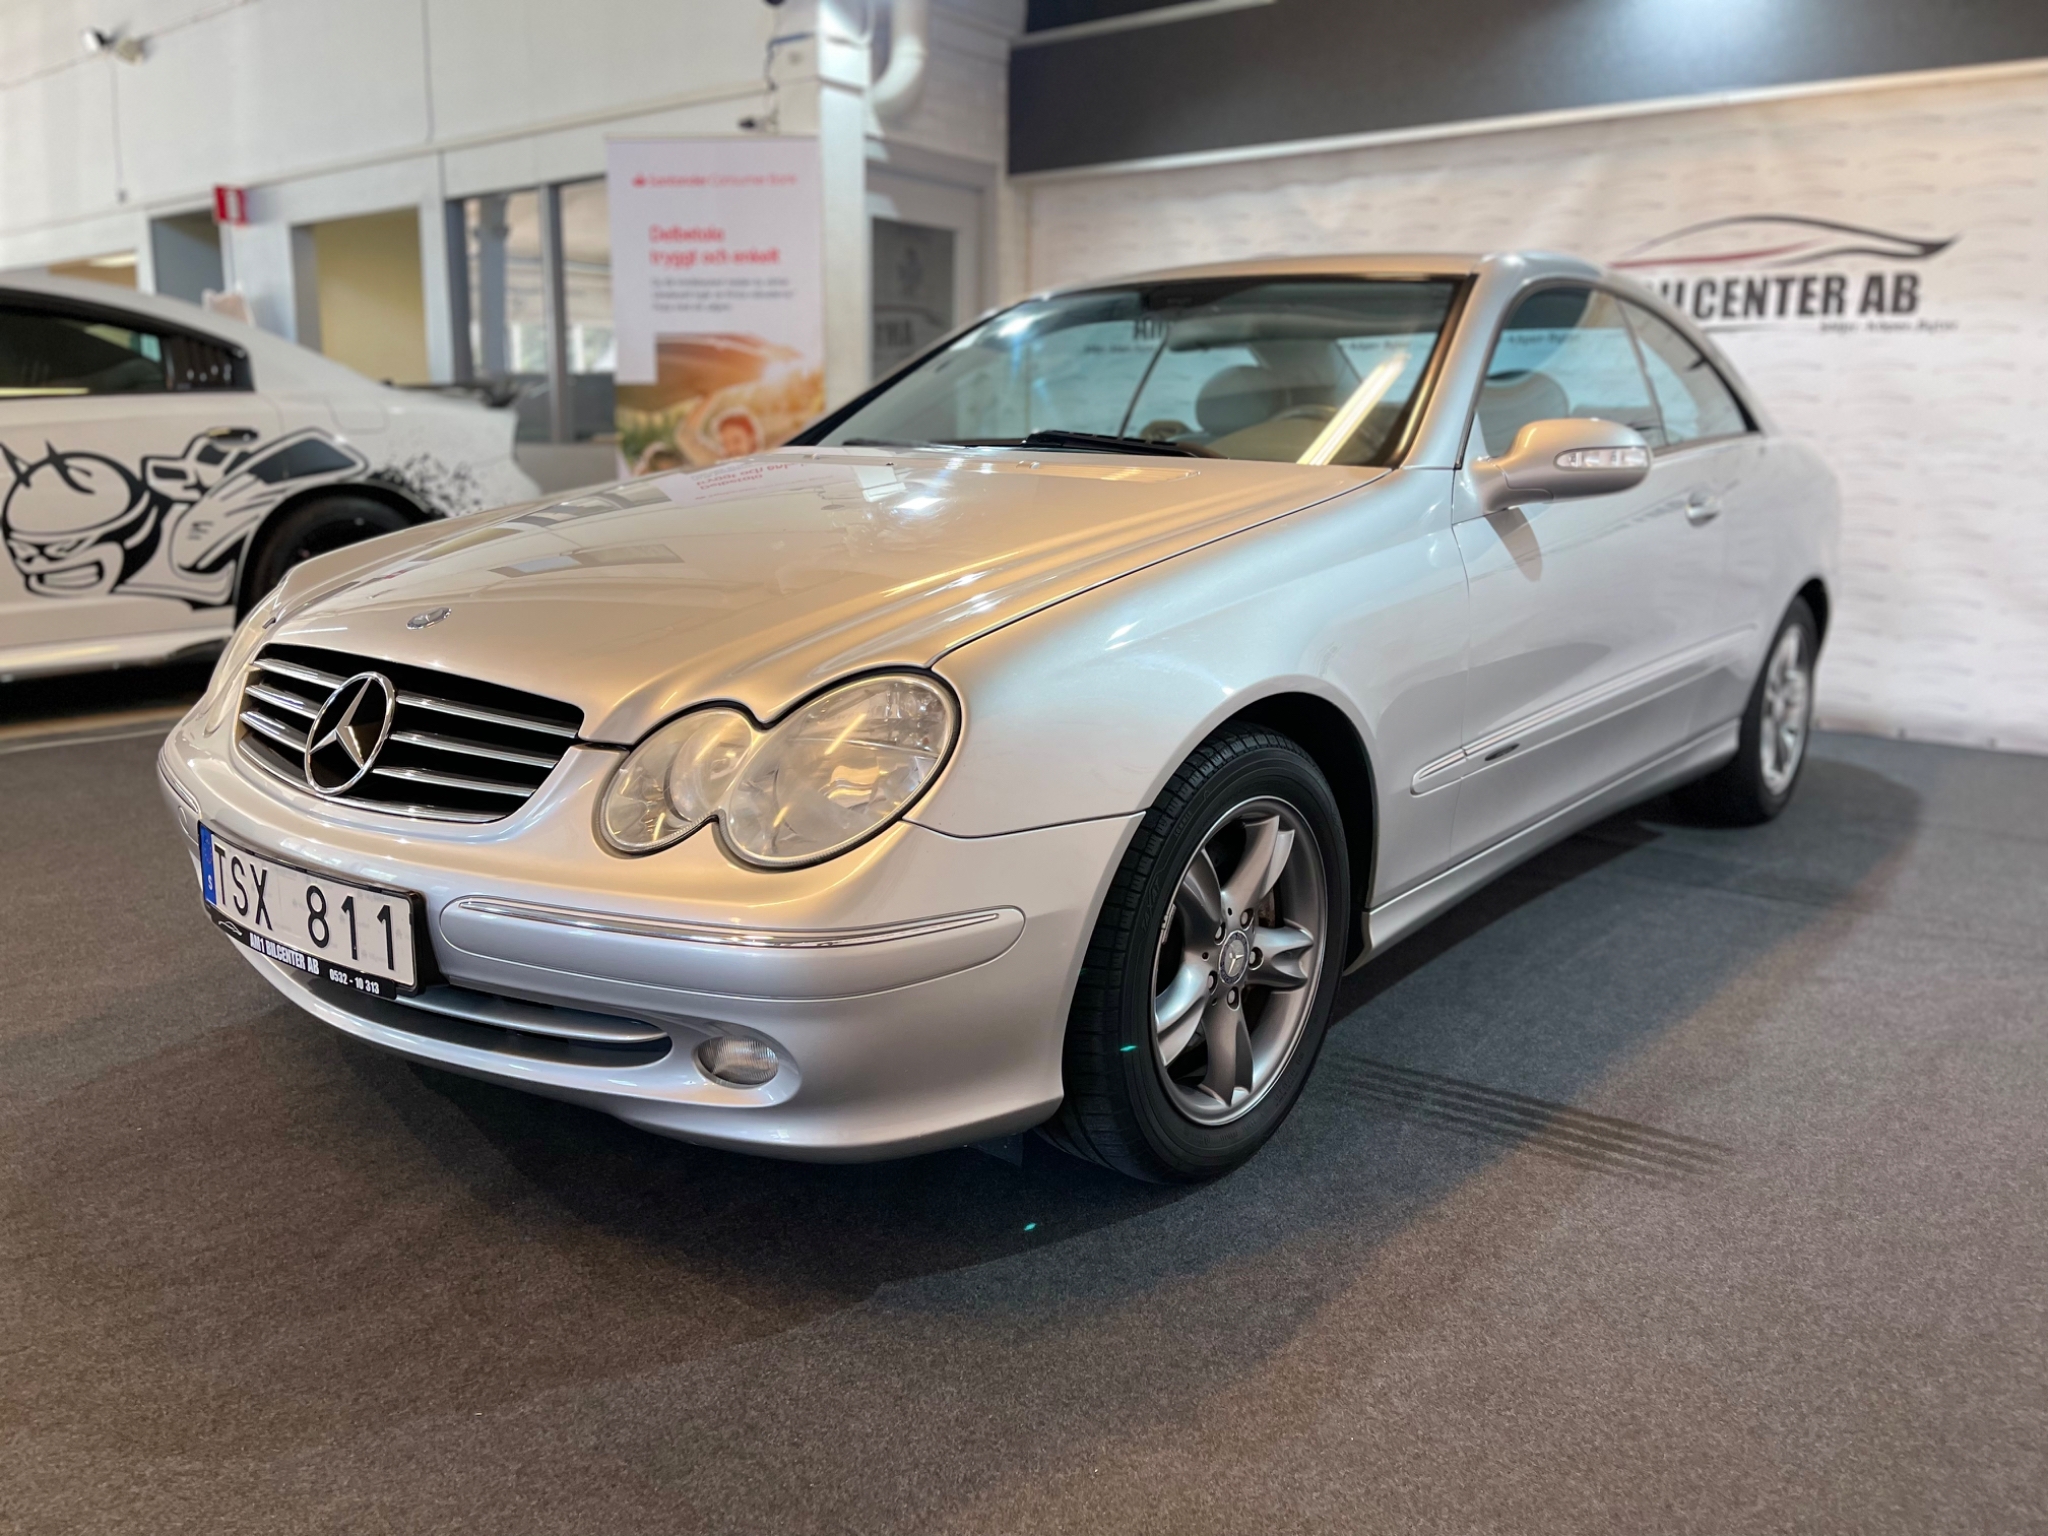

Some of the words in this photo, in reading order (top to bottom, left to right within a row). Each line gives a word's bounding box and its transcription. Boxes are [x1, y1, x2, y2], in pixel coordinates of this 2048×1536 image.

[650, 250, 696, 270] tryggt
[702, 248, 728, 264] och
[732, 247, 779, 264] enkelt
[1660, 274, 1847, 319] CENTER
[1858, 270, 1920, 315] AB
[207, 875, 213, 890] S
[213, 844, 273, 931] TSX
[305, 885, 395, 971] 811
[249, 932, 266, 953] AM1
[265, 938, 306, 971] BILCENTER
[307, 955, 320, 976] AB
[329, 969, 348, 984] 0532
[354, 976, 365, 990] 10
[364, 979, 380, 995] 313
